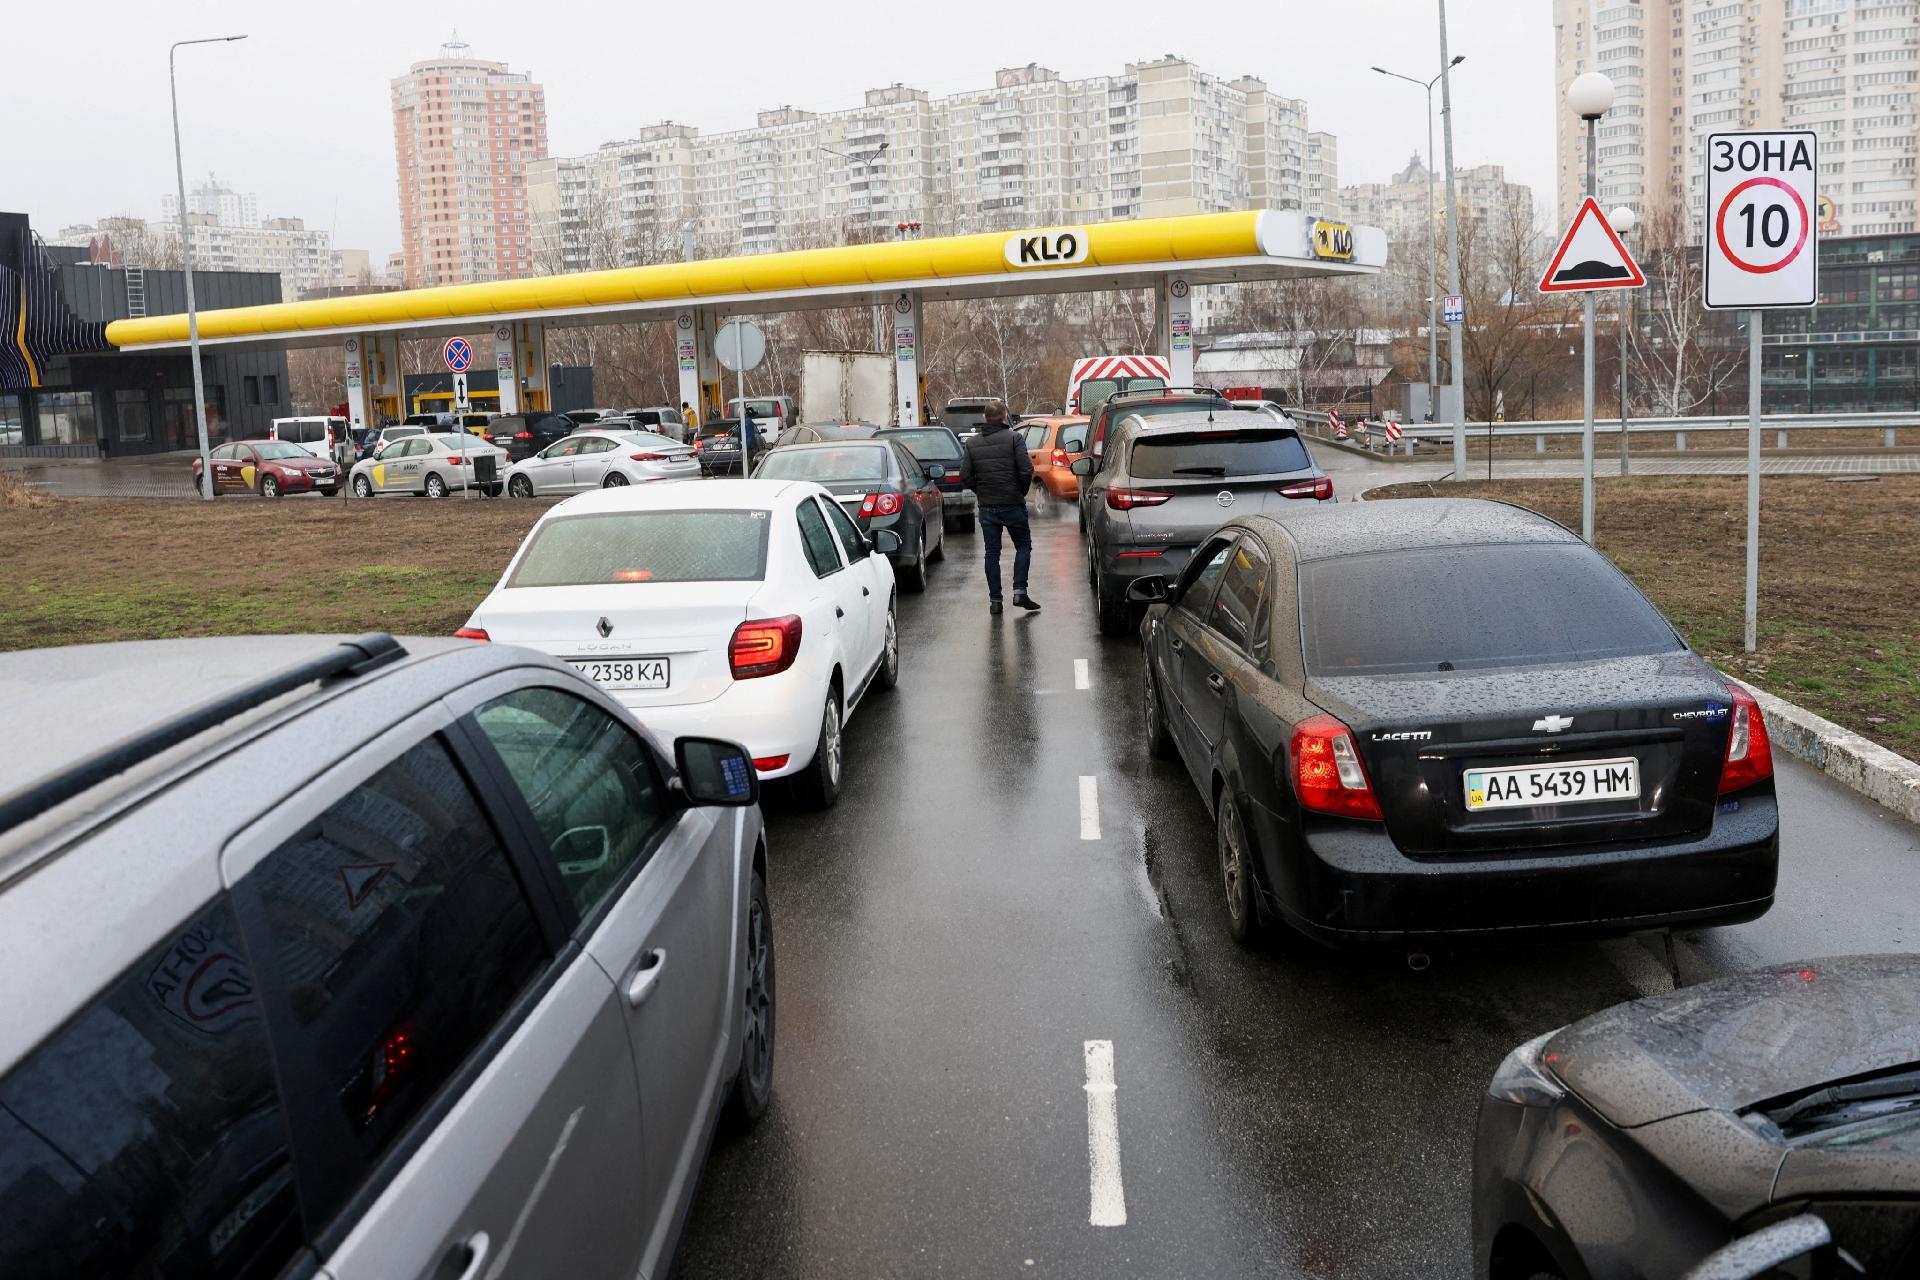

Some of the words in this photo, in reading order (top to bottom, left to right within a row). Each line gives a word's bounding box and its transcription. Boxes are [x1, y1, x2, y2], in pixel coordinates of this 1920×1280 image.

[1713, 140, 1813, 172] ЗОНА
[1740, 203, 1789, 248] 10
[1020, 233, 1077, 263] KLO
[1333, 228, 1352, 254] KLO
[592, 663, 633, 682] 2358
[638, 663, 664, 681] KA
[1672, 708, 1729, 720] CHEVROLET
[1372, 731, 1432, 741] LACETTI
[1487, 776, 1522, 801] AA
[1530, 770, 1586, 798] 5439
[1594, 767, 1630, 793] HM
[1472, 795, 1483, 803] UA
